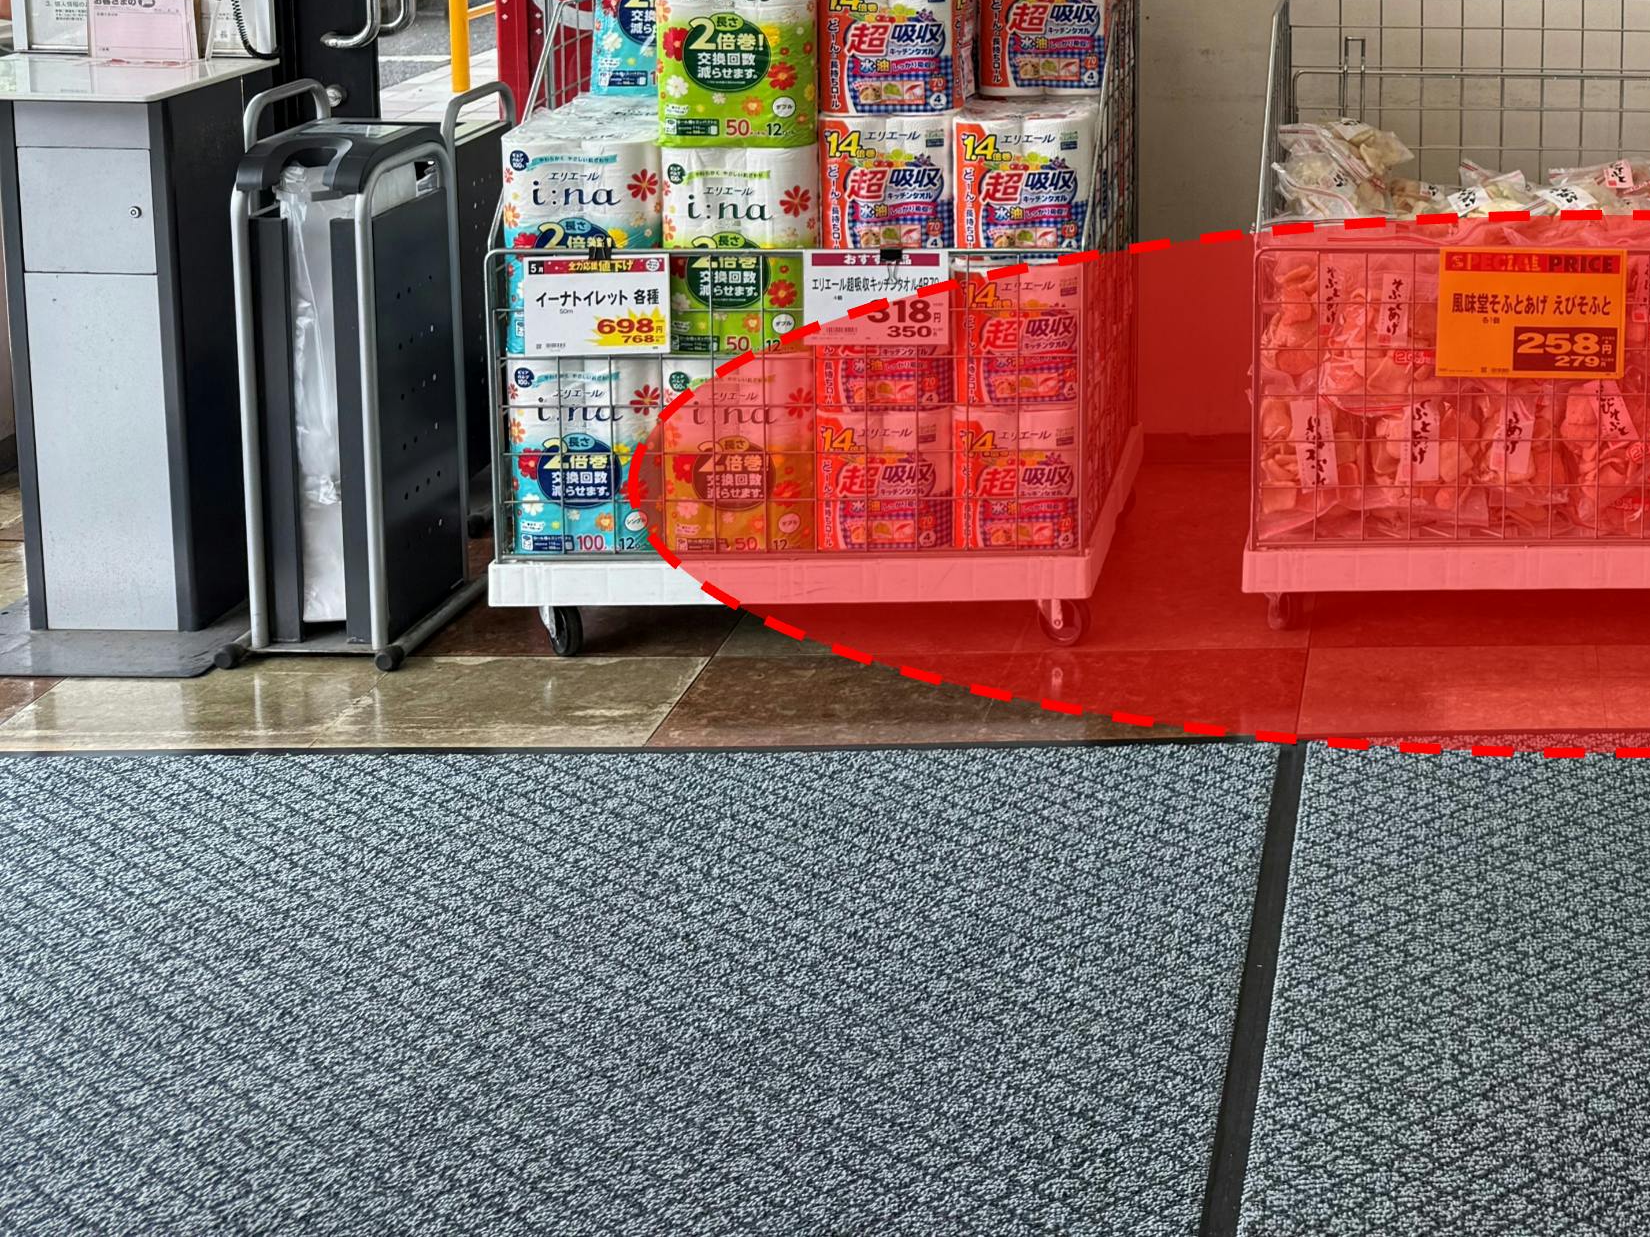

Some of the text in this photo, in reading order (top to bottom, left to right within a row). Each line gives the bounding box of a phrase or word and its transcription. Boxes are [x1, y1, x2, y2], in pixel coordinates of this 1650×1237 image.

[716, 16, 739, 27] 長さ
[1008, 3, 1097, 33] 超吸収
[1047, 27, 1091, 35] キッチンタオル
[846, 23, 943, 56] 超吸収
[889, 47, 936, 56] キッチンタオル
[697, 52, 756, 66] 交換回数
[697, 66, 759, 79] 減らせます。
[726, 119, 751, 136] 50
[766, 123, 782, 136] 12
[864, 130, 920, 141] エリエール
[1001, 133, 1056, 144] エリエール
[548, 171, 600, 182] エリエール
[847, 167, 941, 201] 超吸収
[982, 168, 1076, 203] 超吸収
[532, 180, 621, 207] i:na
[704, 186, 753, 196] エリエール
[887, 192, 933, 201] キッチンタオル
[1022, 194, 1068, 203] キッチンタオル
[688, 194, 774, 221] i:na
[564, 220, 588, 232] 長さ
[718, 235, 740, 247] 長さ
[844, 254, 912, 266] おすす品
[1549, 256, 1614, 273] PRICE
[700, 271, 757, 284] 交換回数
[700, 284, 758, 297] 減らせます。
[536, 288, 660, 308] イーナトイレット 各種
[1452, 292, 1612, 316] 風味堂そふとあげ えびそふと
[597, 317, 664, 335] 698 円
[887, 325, 932, 338] 350
[621, 335, 655, 344] 768
[725, 336, 750, 351] 50
[1516, 332, 1612, 355] 258 円
[1554, 355, 1600, 367] 279
[568, 438, 590, 449] 長さ
[552, 471, 608, 484] 交換回数
[577, 535, 606, 551] 100
